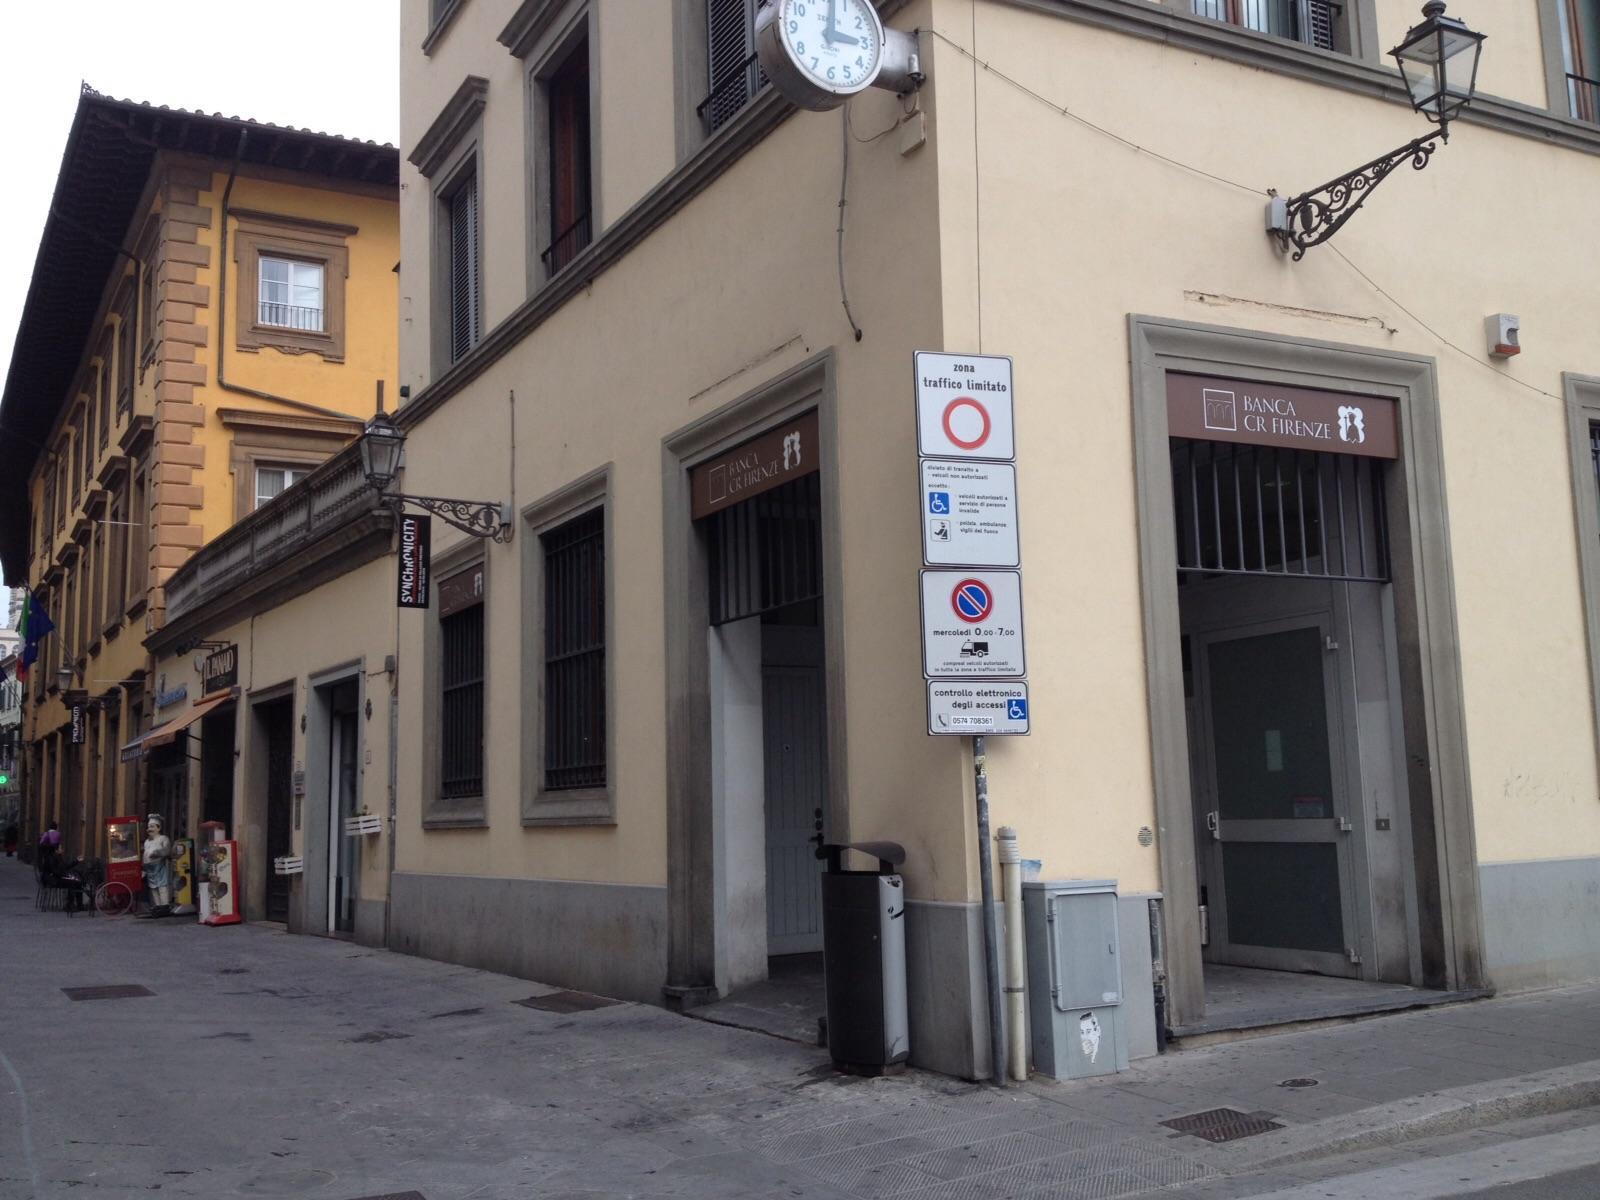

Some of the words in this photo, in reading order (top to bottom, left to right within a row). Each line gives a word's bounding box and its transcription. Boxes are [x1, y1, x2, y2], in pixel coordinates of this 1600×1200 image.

[793, 2, 806, 17] 10
[789, 20, 798, 34] 9
[855, 16, 863, 29] 2
[796, 40, 806, 55] 8
[860, 36, 870, 50] 3
[810, 56, 820, 70] 7
[855, 55, 865, 69] 4
[826, 66, 836, 80] 6
[842, 65, 852, 79] 5
[953, 364, 975, 373] zona
[923, 377, 962, 389] traffico
[967, 379, 1007, 391] limitato
[1243, 395, 1296, 417] BANCA
[1243, 414, 1266, 433] CR
[1271, 417, 1332, 440] FIRENZE
[934, 689, 973, 697] controllo
[976, 689, 1022, 698] elettronico
[952, 701, 973, 710] degli
[975, 701, 1006, 709] accessi
